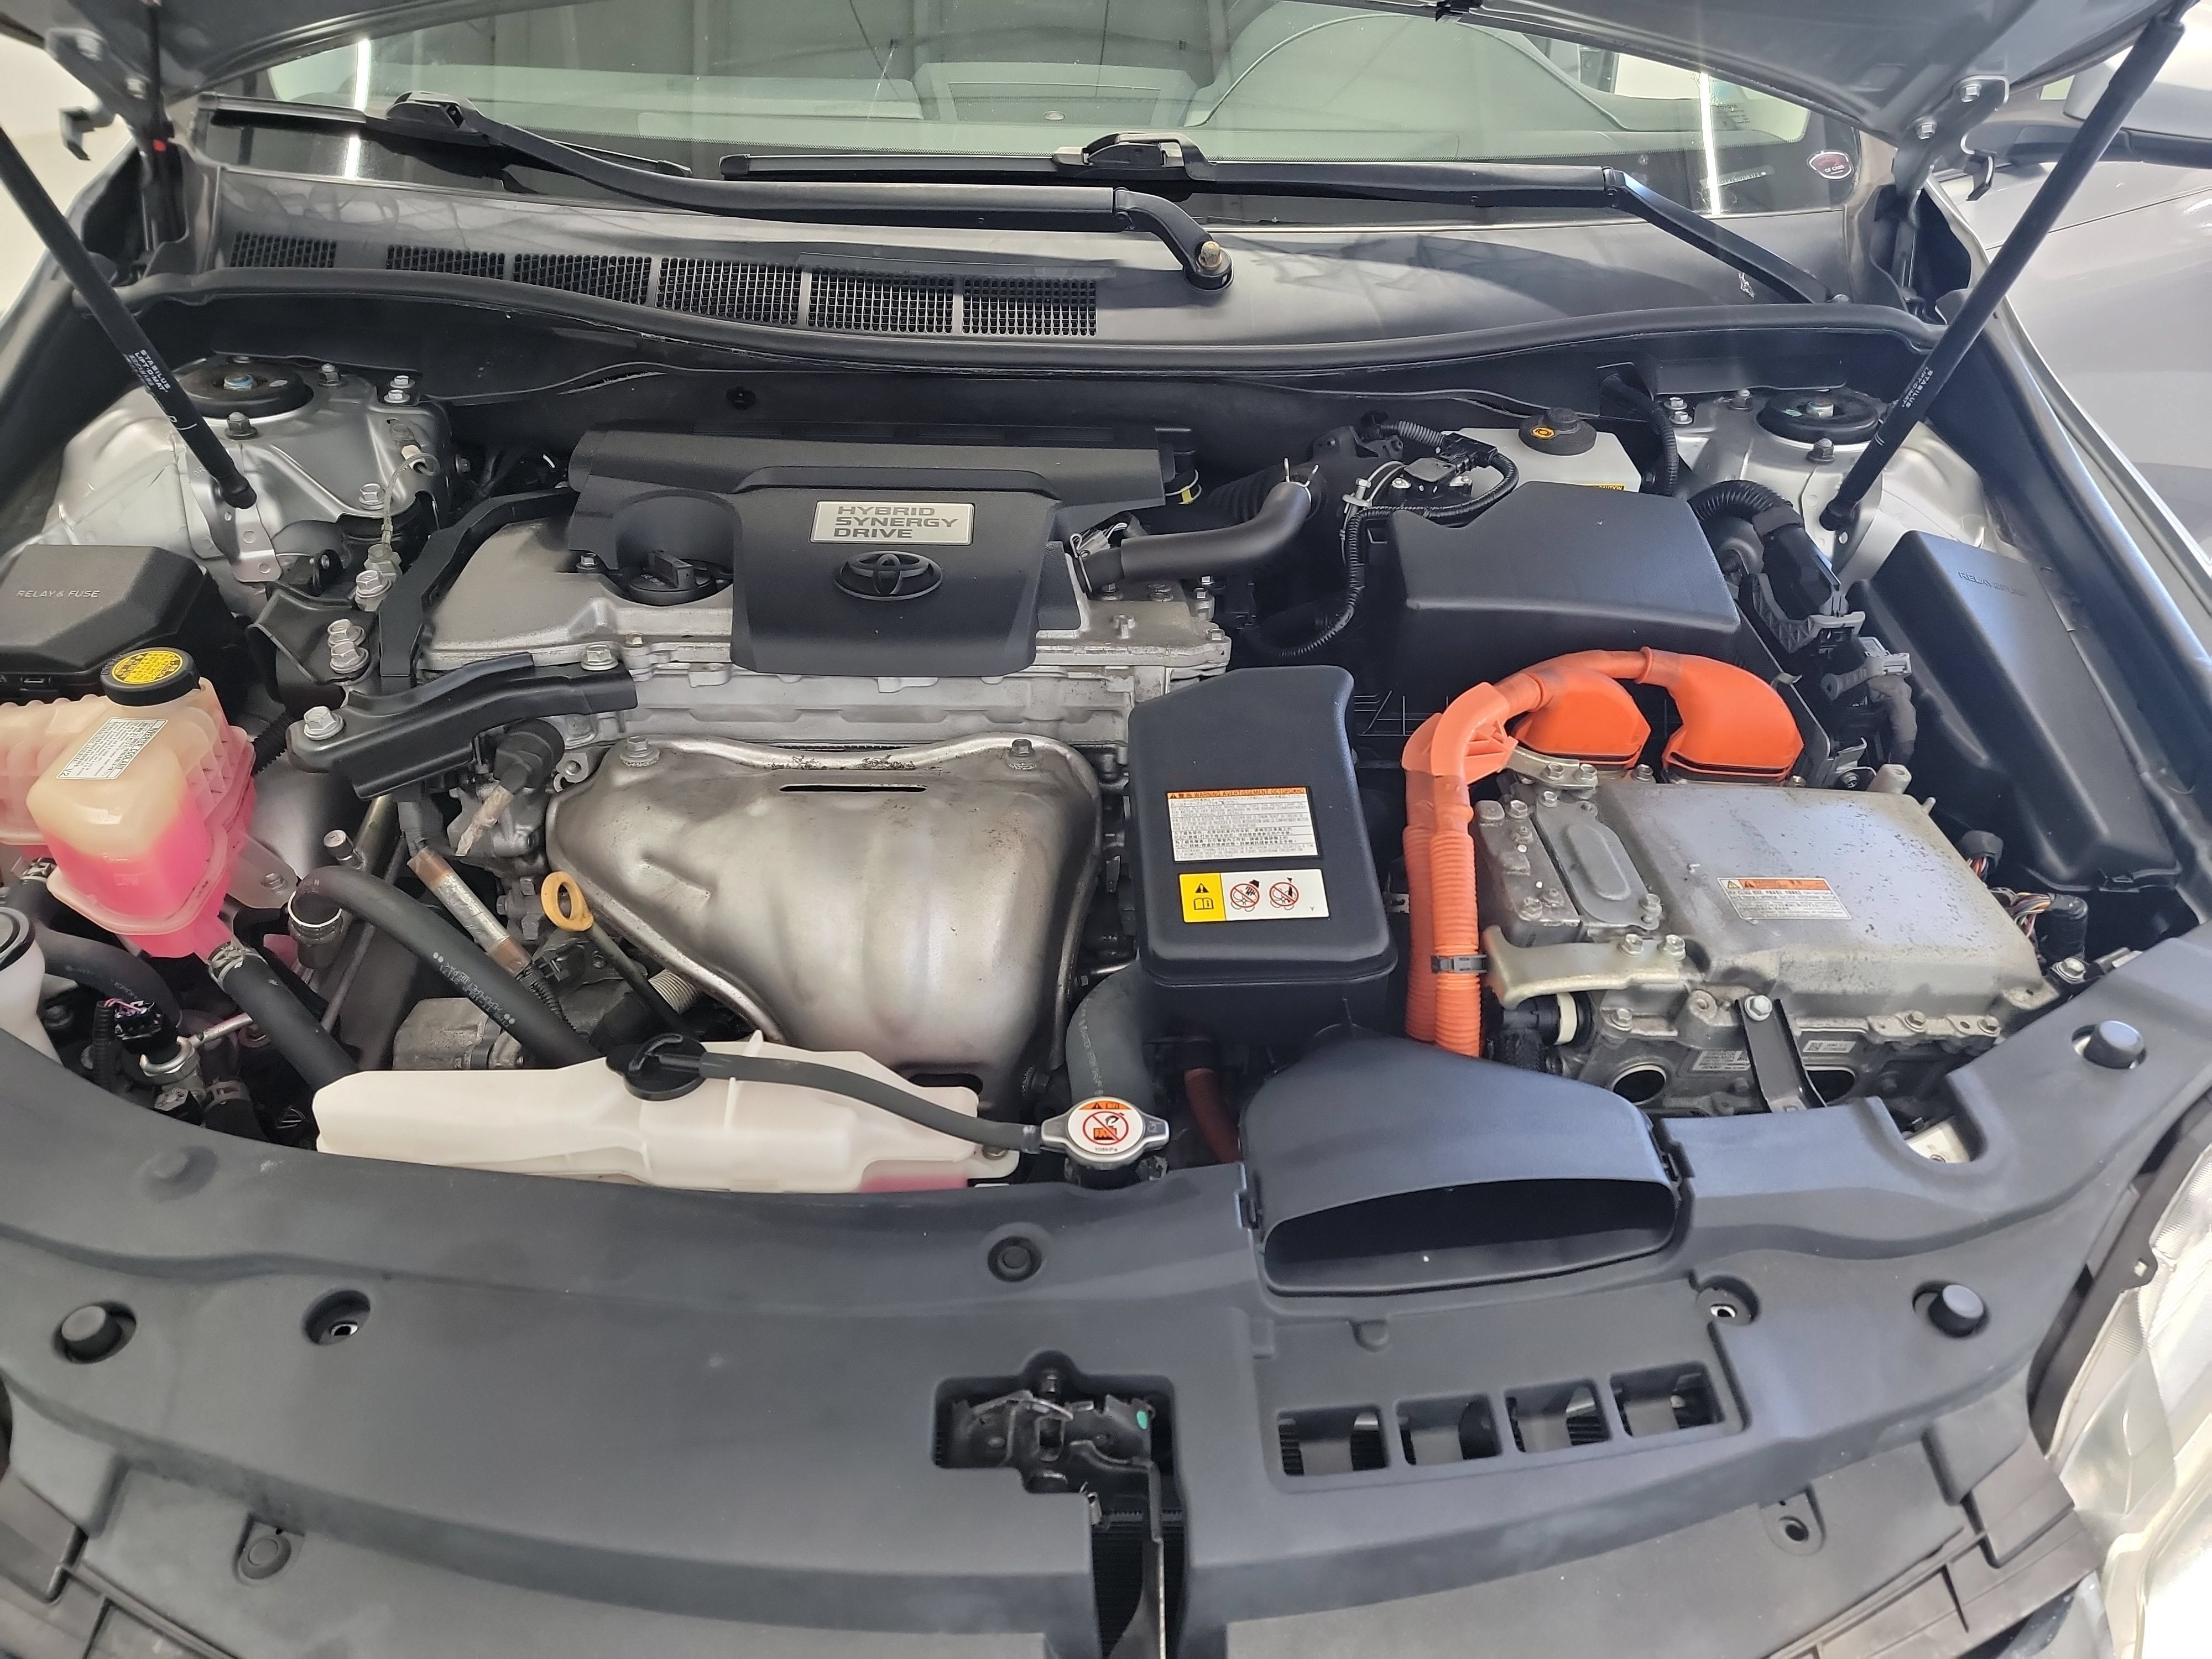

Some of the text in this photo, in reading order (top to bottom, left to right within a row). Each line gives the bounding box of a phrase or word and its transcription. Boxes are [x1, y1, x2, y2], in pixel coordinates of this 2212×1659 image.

[140, 349, 171, 389] STABILUS
[837, 506, 935, 516] HYBRID
[835, 517, 958, 528] SYNERGY
[833, 528, 913, 539] DRIVE
[157, 661, 174, 677] CAUTION
[115, 727, 159, 770] INVERTER COOLANT
